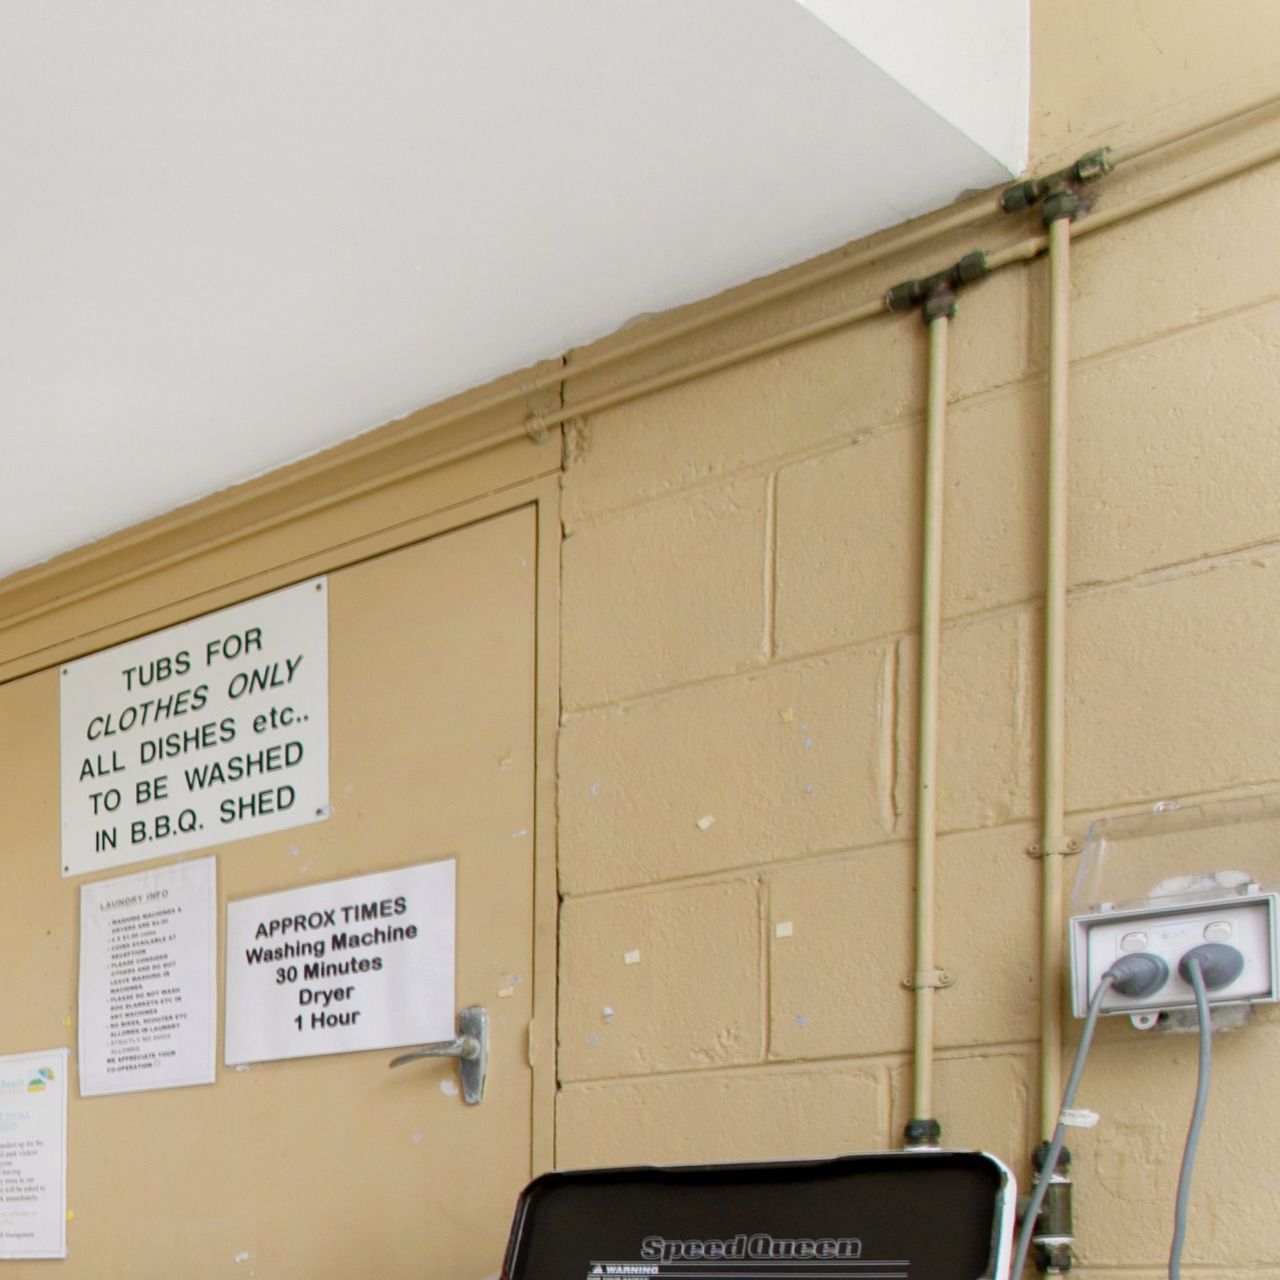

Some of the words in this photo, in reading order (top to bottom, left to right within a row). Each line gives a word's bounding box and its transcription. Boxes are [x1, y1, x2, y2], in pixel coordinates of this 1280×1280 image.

[122, 650, 191, 691] TUBS
[206, 627, 262, 666] FOR
[86, 684, 208, 741] CLOTHES
[227, 655, 303, 699] ONLY
[80, 750, 125, 780] ALL
[140, 717, 236, 765] DISHES
[252, 705, 309, 733] etc..
[89, 788, 121, 815] TO
[135, 776, 168, 806] BE
[185, 740, 303, 792] WASHED
[96, 827, 116, 852] IN
[131, 807, 204, 844] B.B.Q.
[219, 784, 295, 824] SHED
[100, 894, 143, 912] LAUNDRY
[146, 889, 168, 902] INFO
[255, 909, 336, 939] APPROX
[341, 896, 407, 924] TIMES
[245, 940, 325, 965] Washing
[332, 923, 417, 950] Machine
[276, 967, 297, 984] 30
[304, 955, 383, 980] Minutes
[300, 985, 355, 1007] Dryer
[295, 1015, 302, 1030] 1
[311, 1010, 360, 1029] Hour
[606, 1266, 659, 1274] WARNING
